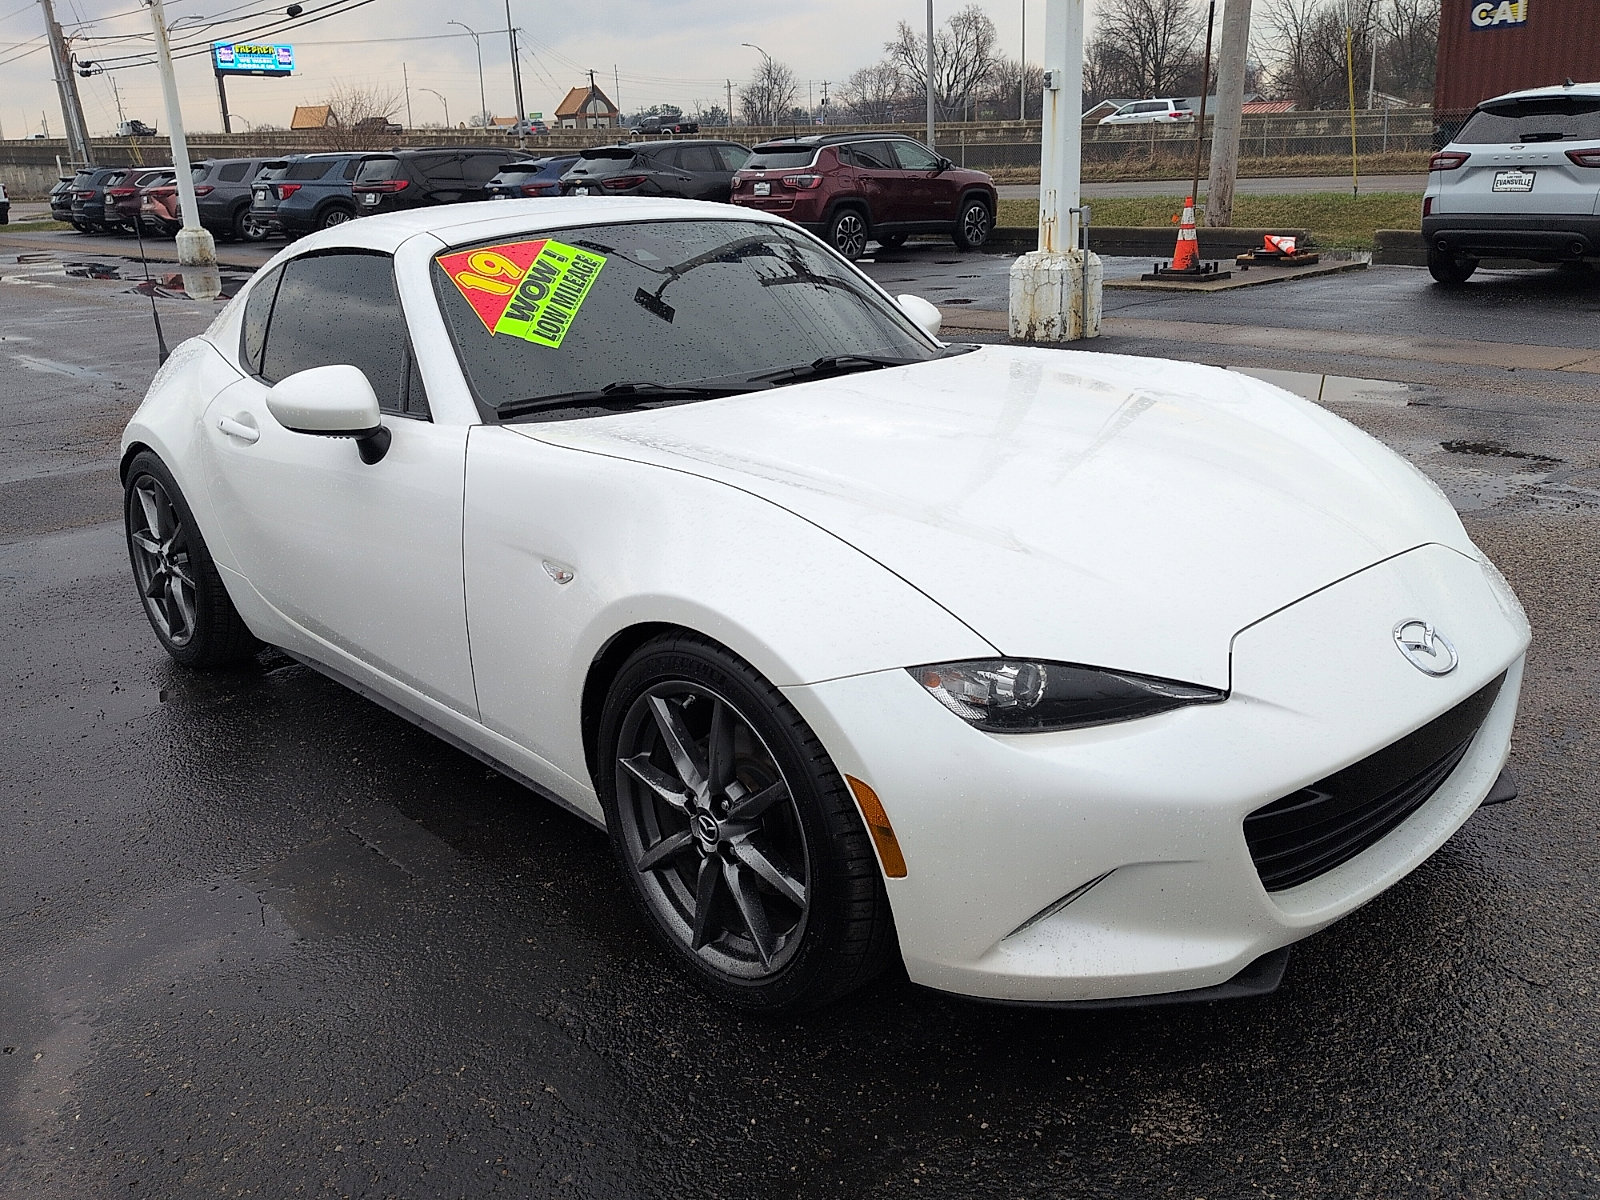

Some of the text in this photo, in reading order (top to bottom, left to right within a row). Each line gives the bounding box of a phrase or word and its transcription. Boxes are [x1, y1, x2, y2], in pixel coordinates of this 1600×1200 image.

[1496, 178, 1532, 187] EVANSVILLE
[454, 250, 526, 296] 19
[532, 253, 599, 342] LOW MILEAGE
